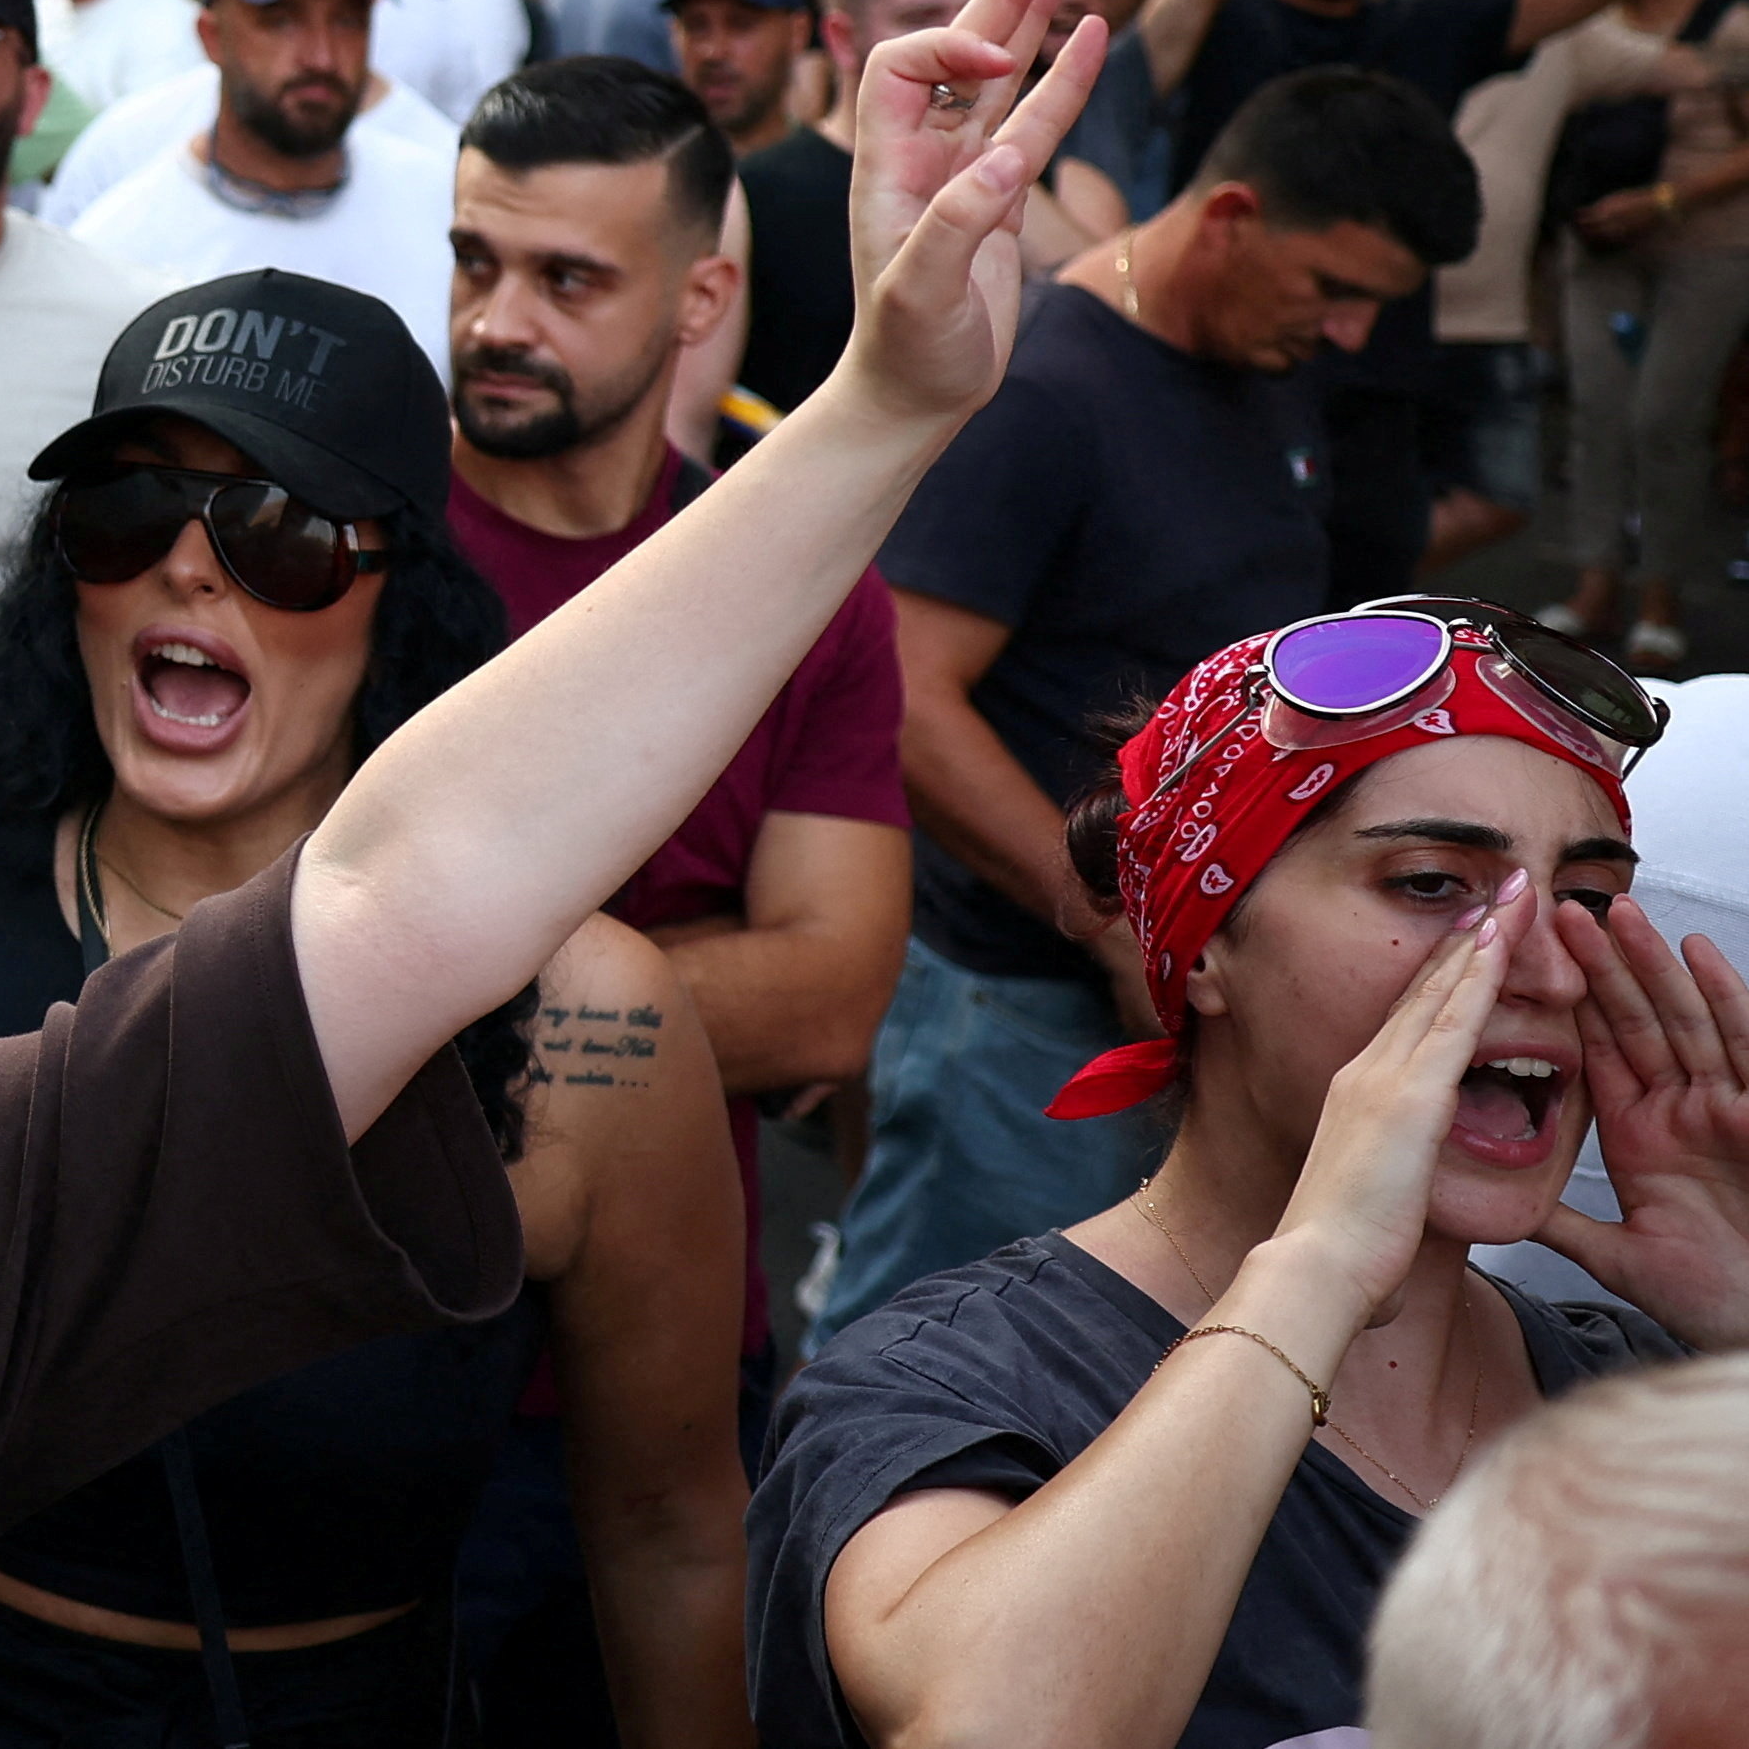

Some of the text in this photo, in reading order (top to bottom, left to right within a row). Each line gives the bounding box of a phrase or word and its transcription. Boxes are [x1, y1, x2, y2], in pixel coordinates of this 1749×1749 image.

[154, 307, 347, 376] DON'T
[141, 353, 326, 412] DISTURB ME
